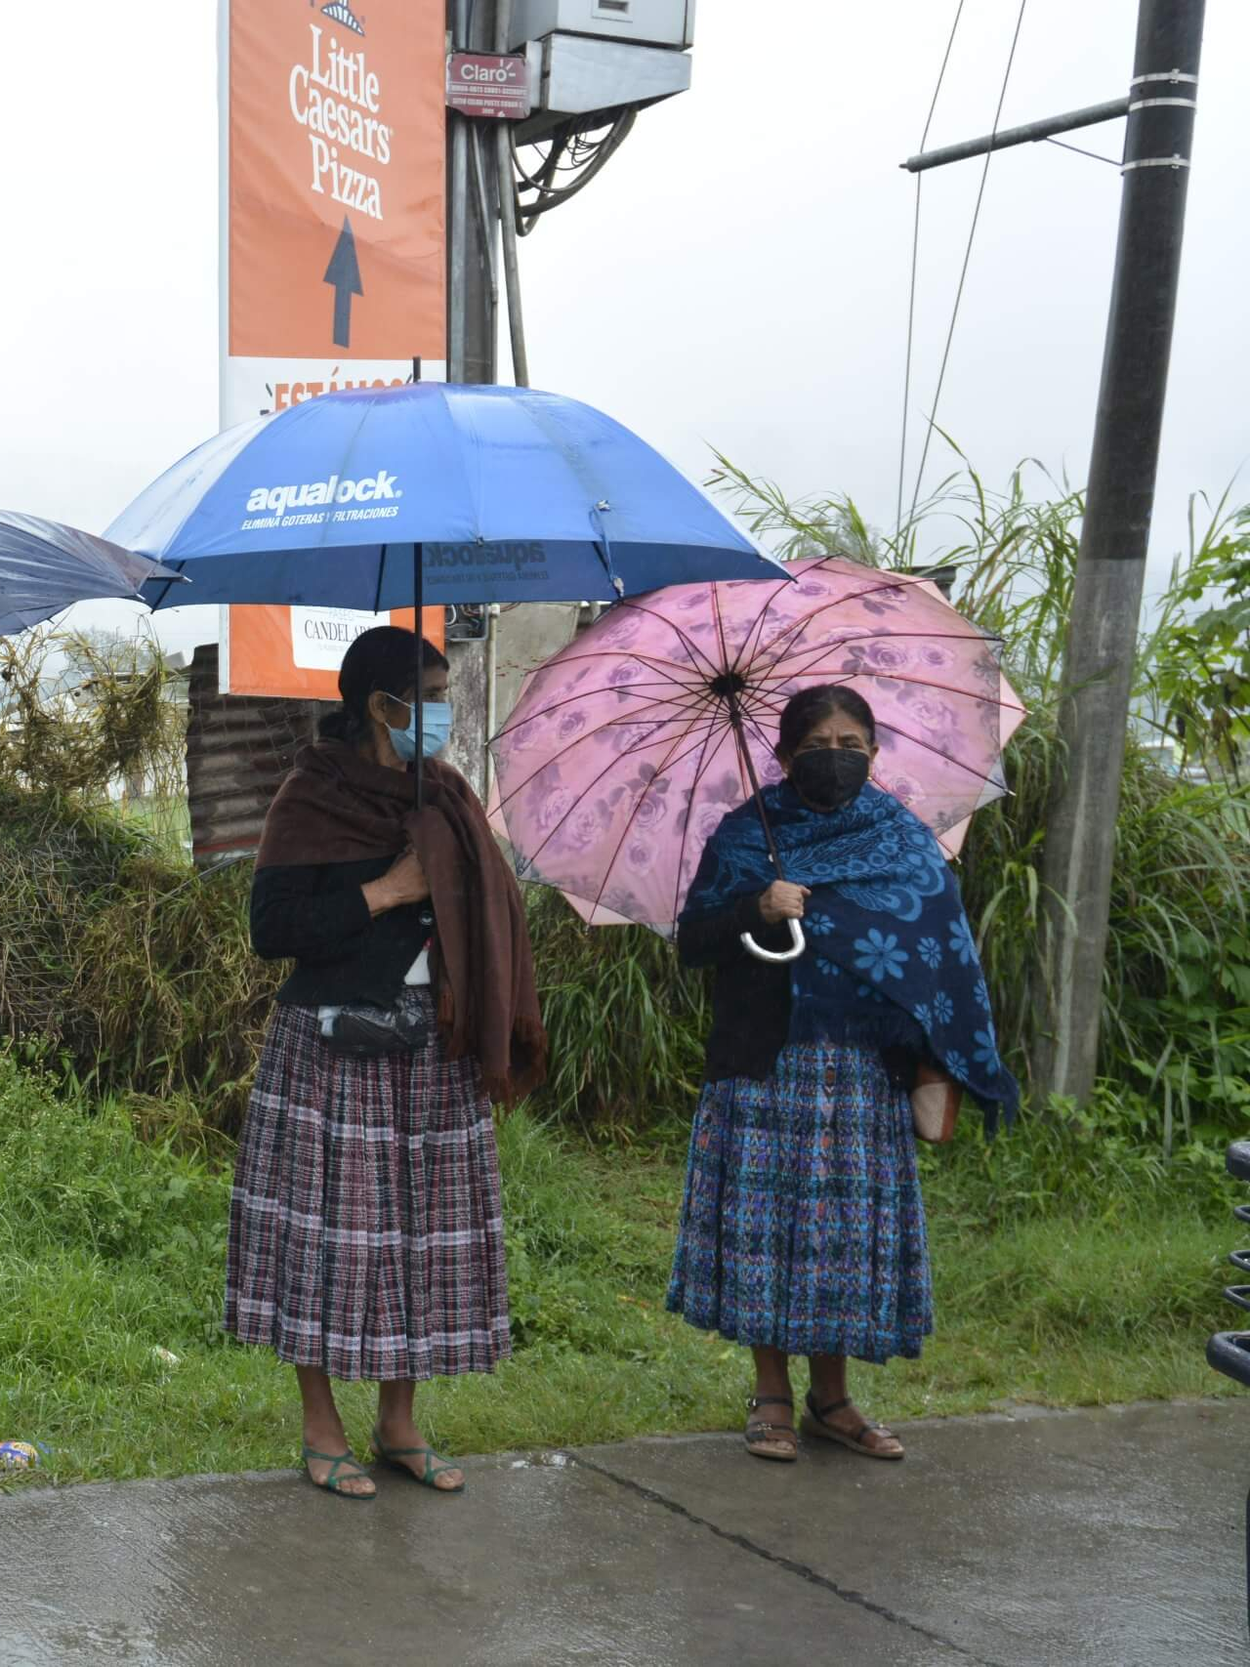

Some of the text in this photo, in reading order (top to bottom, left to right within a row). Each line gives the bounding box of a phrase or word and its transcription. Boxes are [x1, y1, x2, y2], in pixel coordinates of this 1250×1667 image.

[309, 23, 379, 113] Little
[461, 63, 508, 82] Claro
[289, 64, 391, 164] Caesars
[309, 134, 383, 220] Pizza
[241, 517, 280, 530] ELIMINA
[281, 512, 325, 527] GOTERAS
[332, 506, 399, 523] FILTRACIONES
